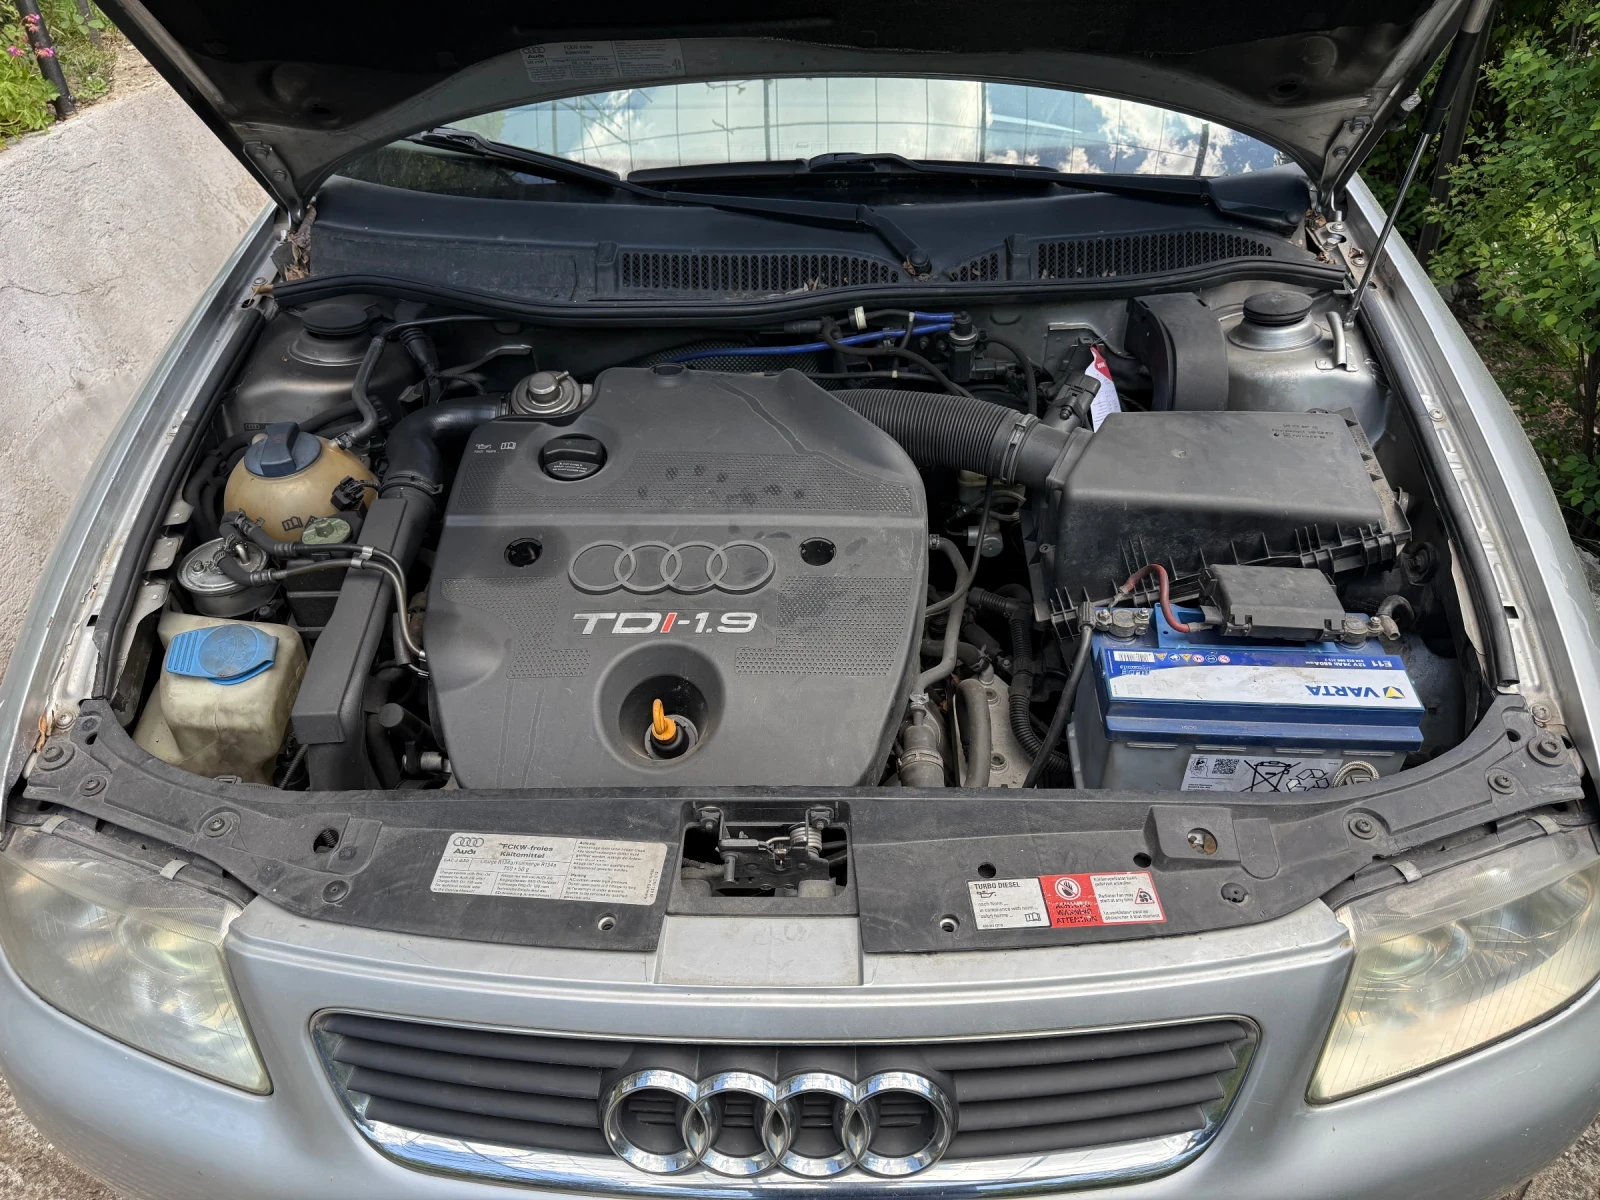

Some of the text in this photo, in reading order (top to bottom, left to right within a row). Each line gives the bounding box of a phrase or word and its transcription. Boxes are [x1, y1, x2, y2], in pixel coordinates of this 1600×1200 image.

[573, 612, 758, 634] TDI-1.9
[1370, 660, 1392, 668] E11
[1305, 684, 1380, 698] VARTA
[1056, 916, 1098, 924] ATTENTION
